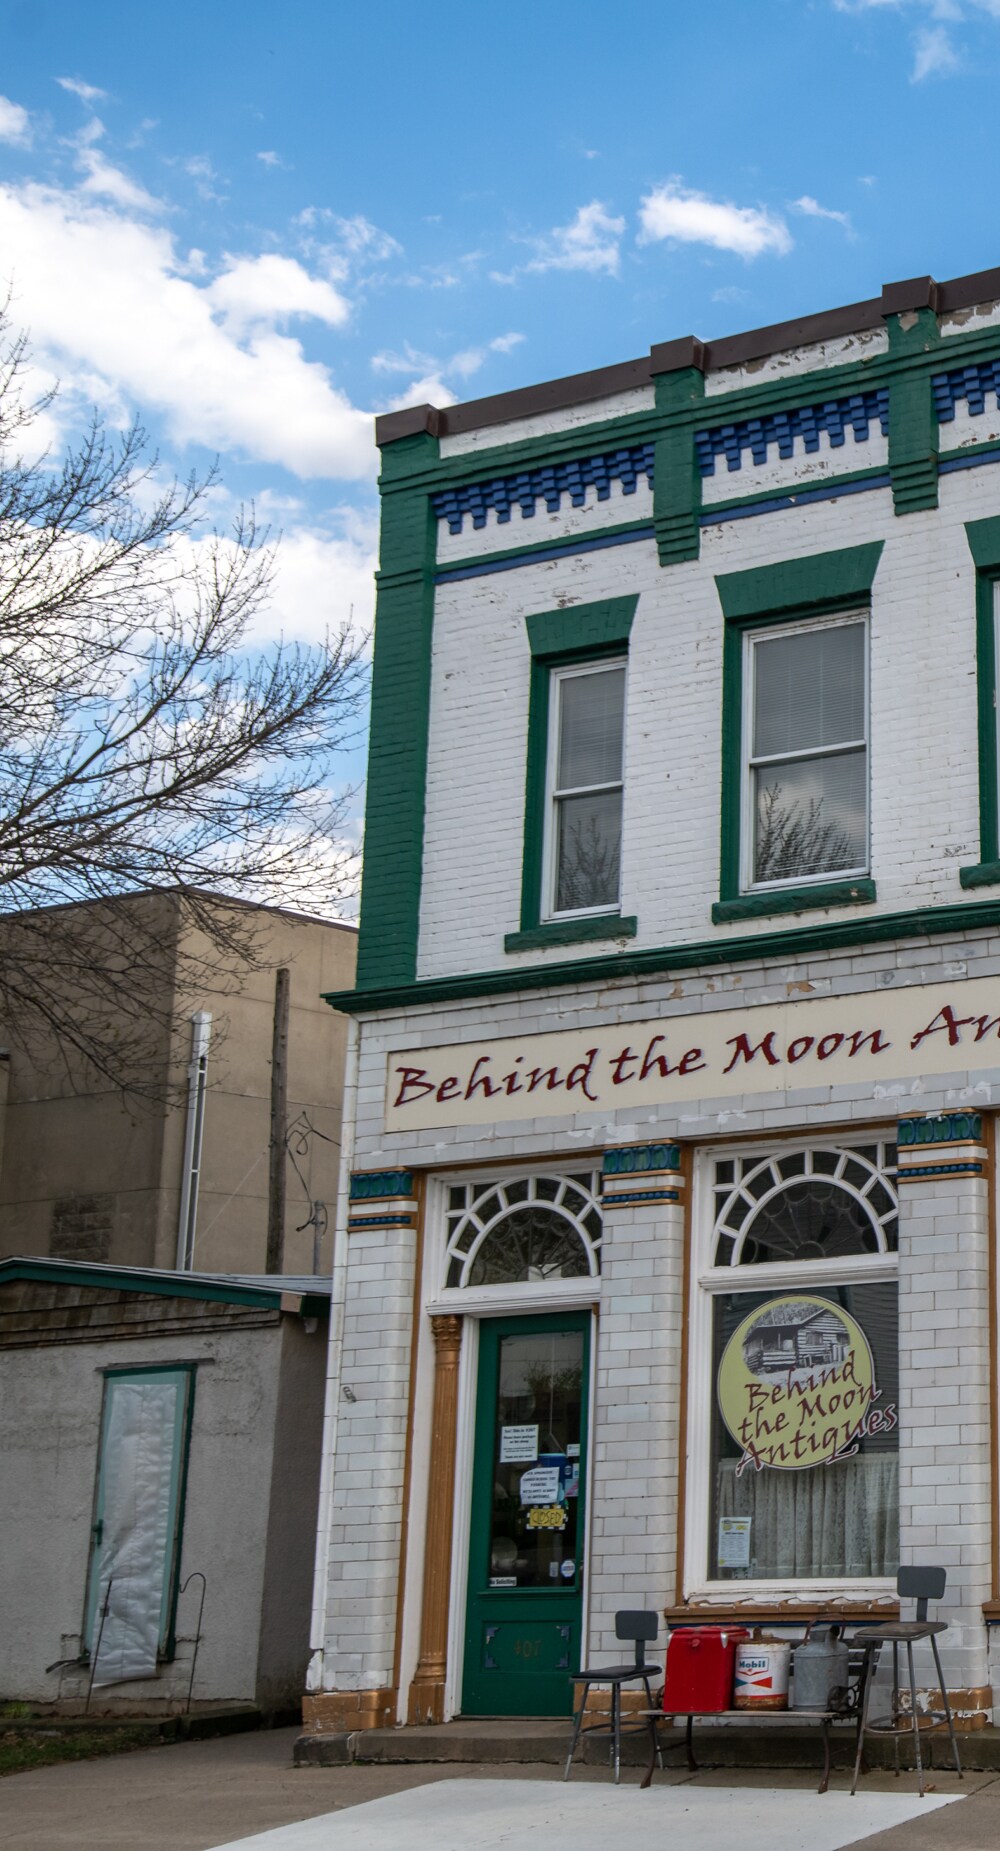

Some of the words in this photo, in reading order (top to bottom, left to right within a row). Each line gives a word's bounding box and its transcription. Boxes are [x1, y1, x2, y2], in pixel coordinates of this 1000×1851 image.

[393, 1047, 600, 1108] Behind
[609, 1035, 706, 1085] the
[722, 1029, 891, 1074] Moon
[744, 1350, 862, 1413] Behind
[736, 1404, 898, 1477] Antiques
[737, 1406, 790, 1444] the
[797, 1384, 880, 1427] Moon
[532, 1510, 562, 1525] CLOSED
[738, 1660, 766, 1669] Mobil
